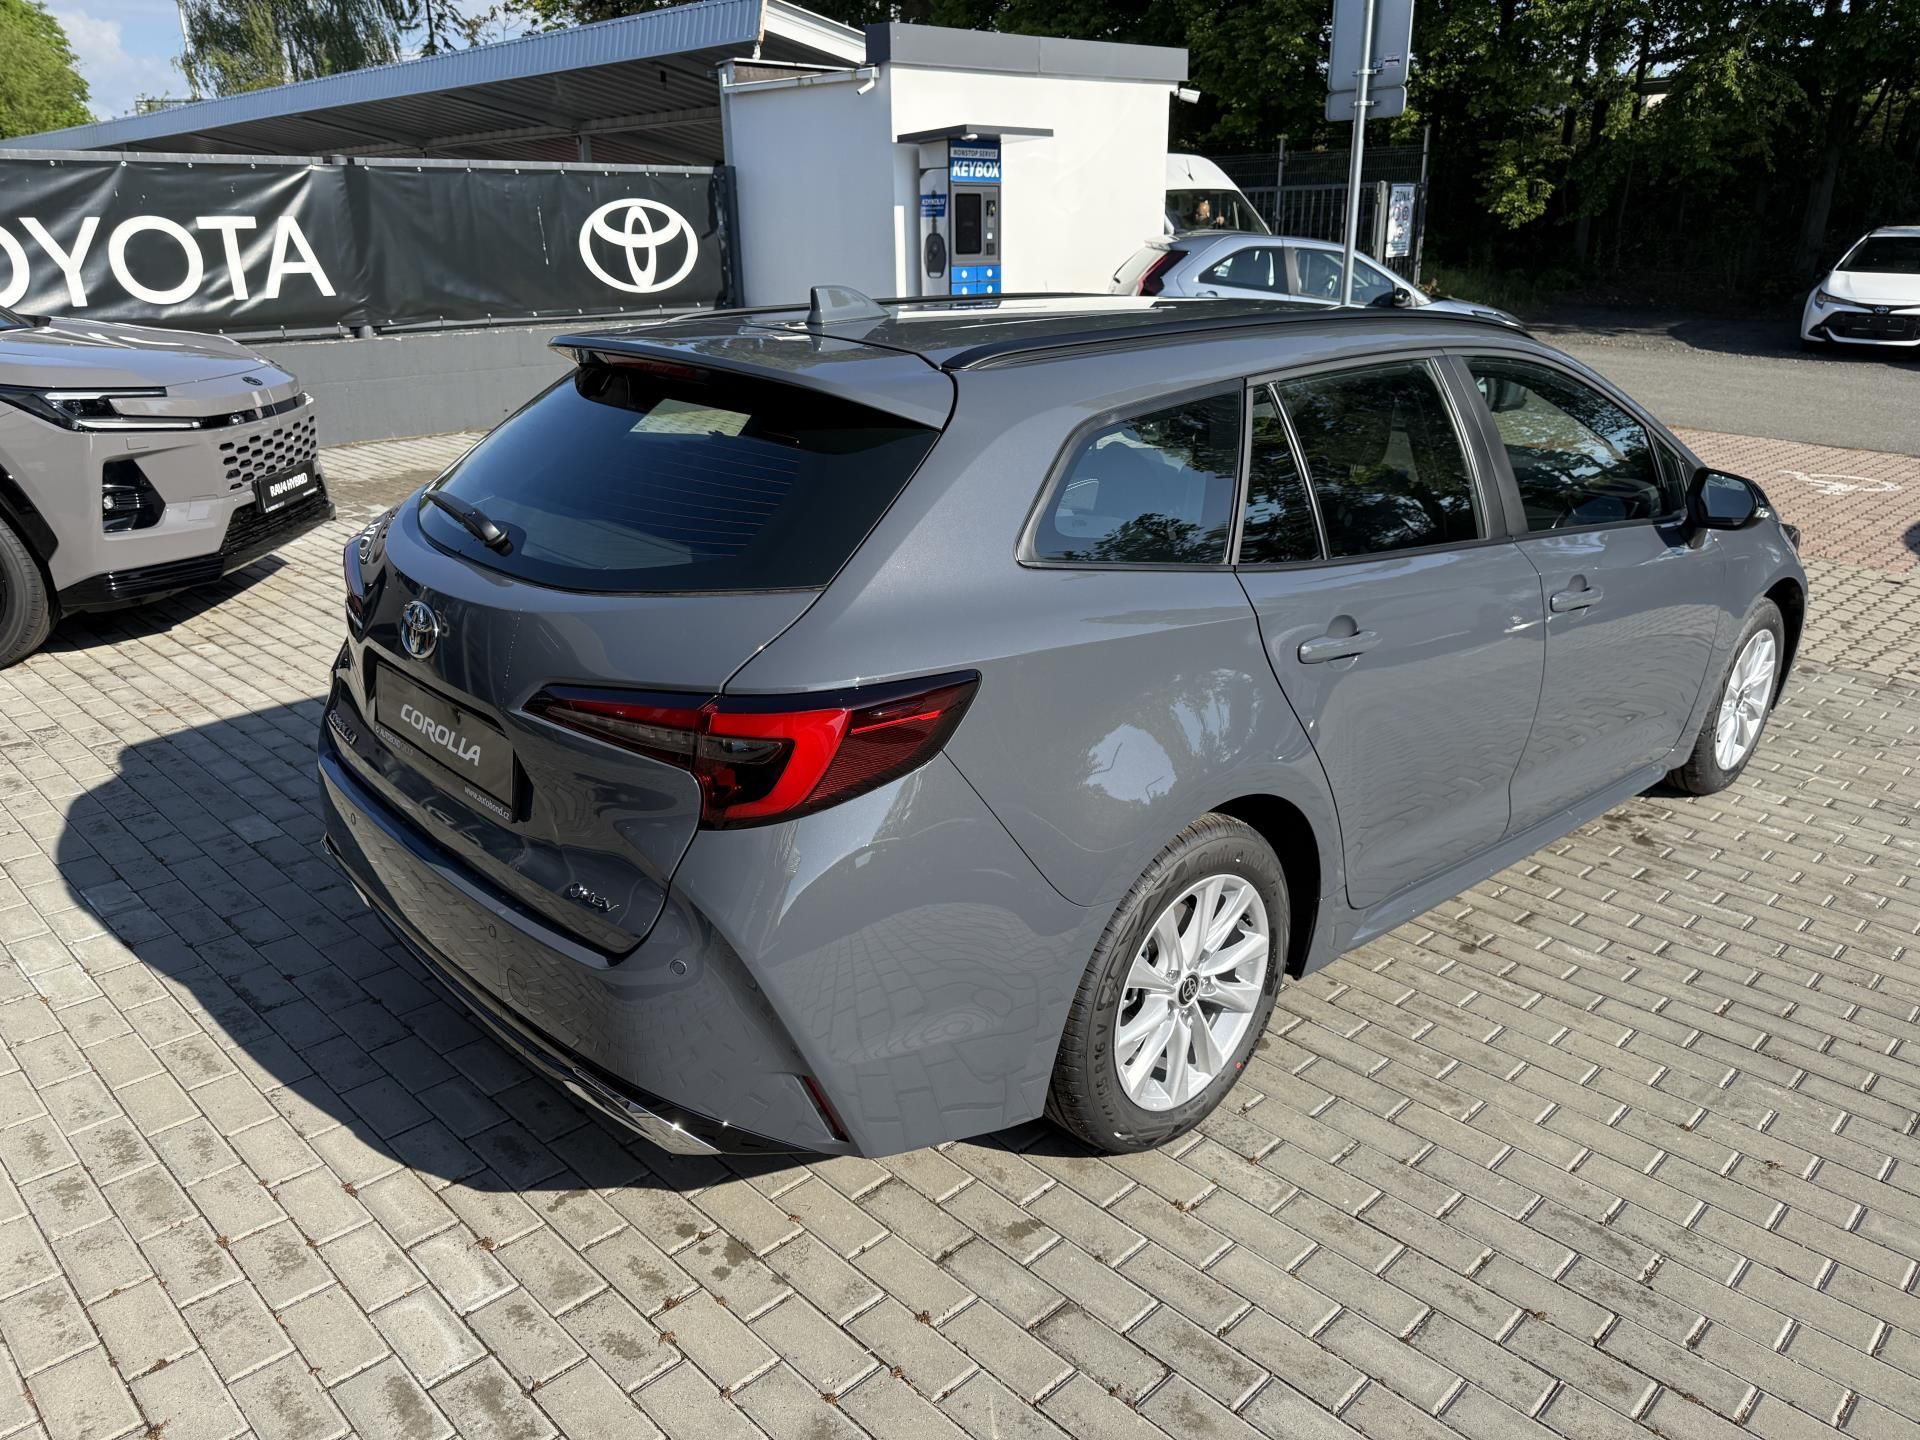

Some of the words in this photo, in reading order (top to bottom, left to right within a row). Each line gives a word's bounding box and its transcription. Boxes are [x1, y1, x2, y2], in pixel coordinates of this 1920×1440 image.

[953, 149, 978, 157] NONSTOP
[952, 160, 1000, 178] KEYBOX
[269, 480, 288, 498] RAV4
[286, 472, 308, 491] HYBRID
[400, 703, 481, 767] COROLLA
